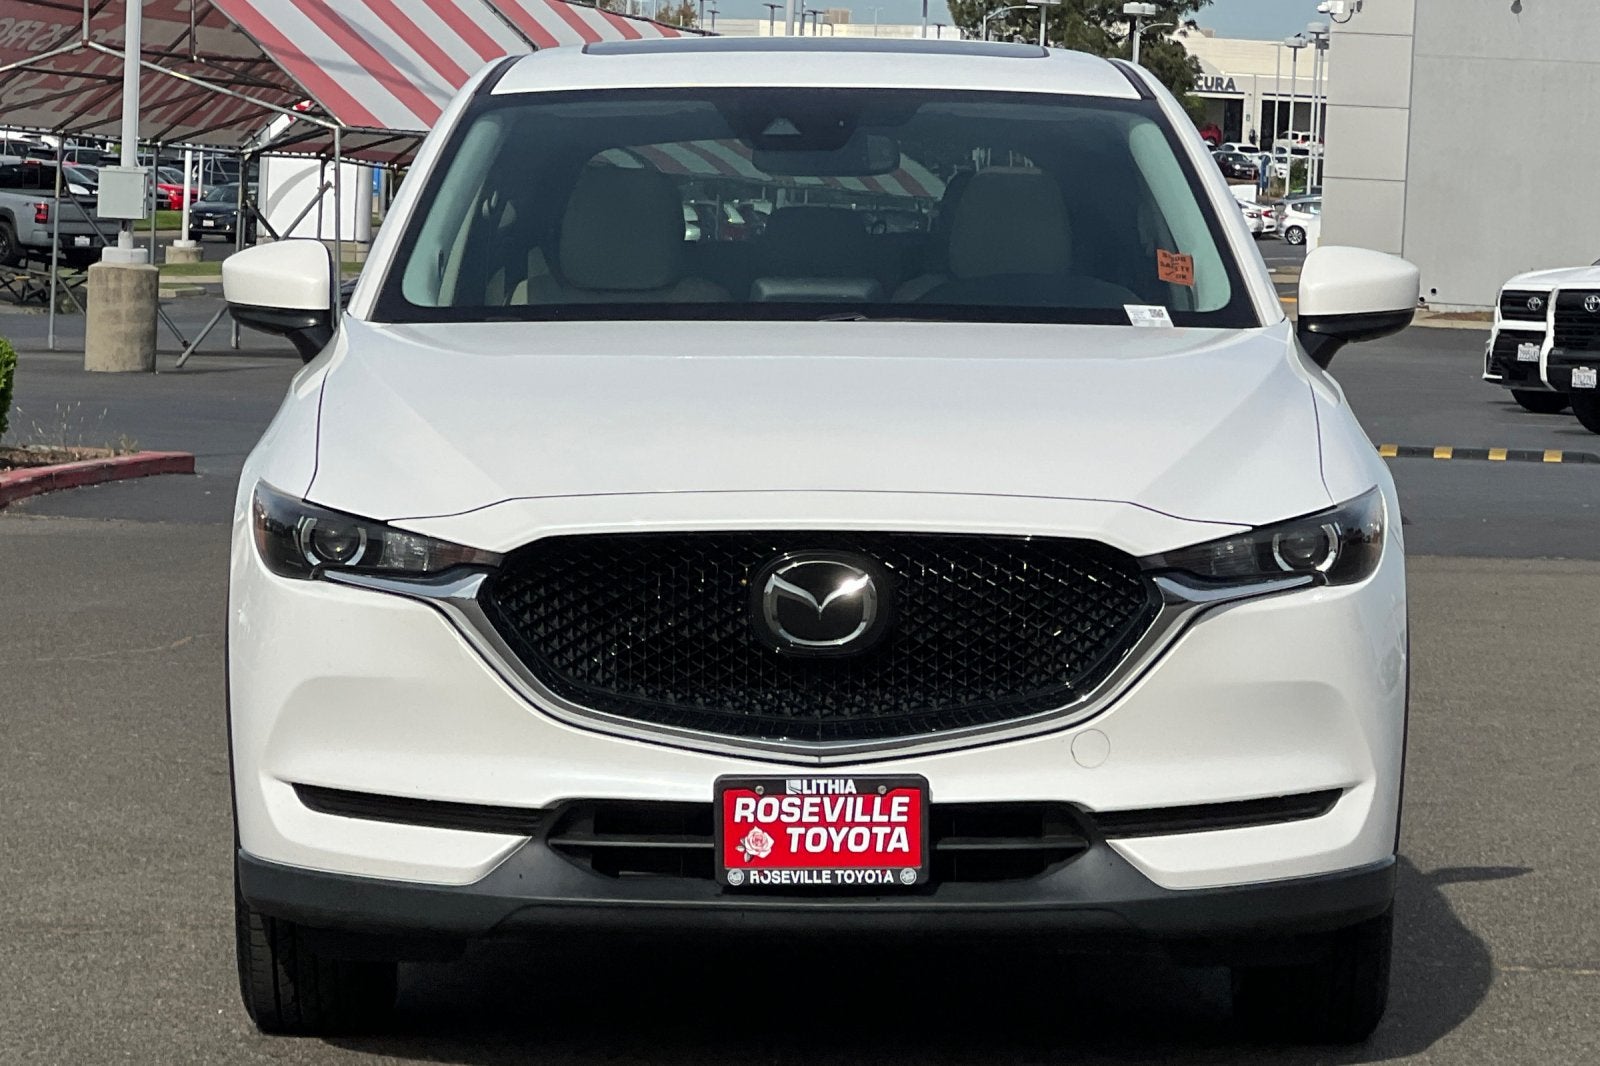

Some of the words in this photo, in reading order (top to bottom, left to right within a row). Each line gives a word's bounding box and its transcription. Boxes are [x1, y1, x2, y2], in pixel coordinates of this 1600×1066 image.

[802, 779, 857, 794] LITHIA
[733, 796, 910, 823] ROSEVILLE
[786, 826, 910, 853] TOYOTA
[750, 870, 831, 884] ROSEVILLE
[835, 870, 894, 884] TOYOTA
